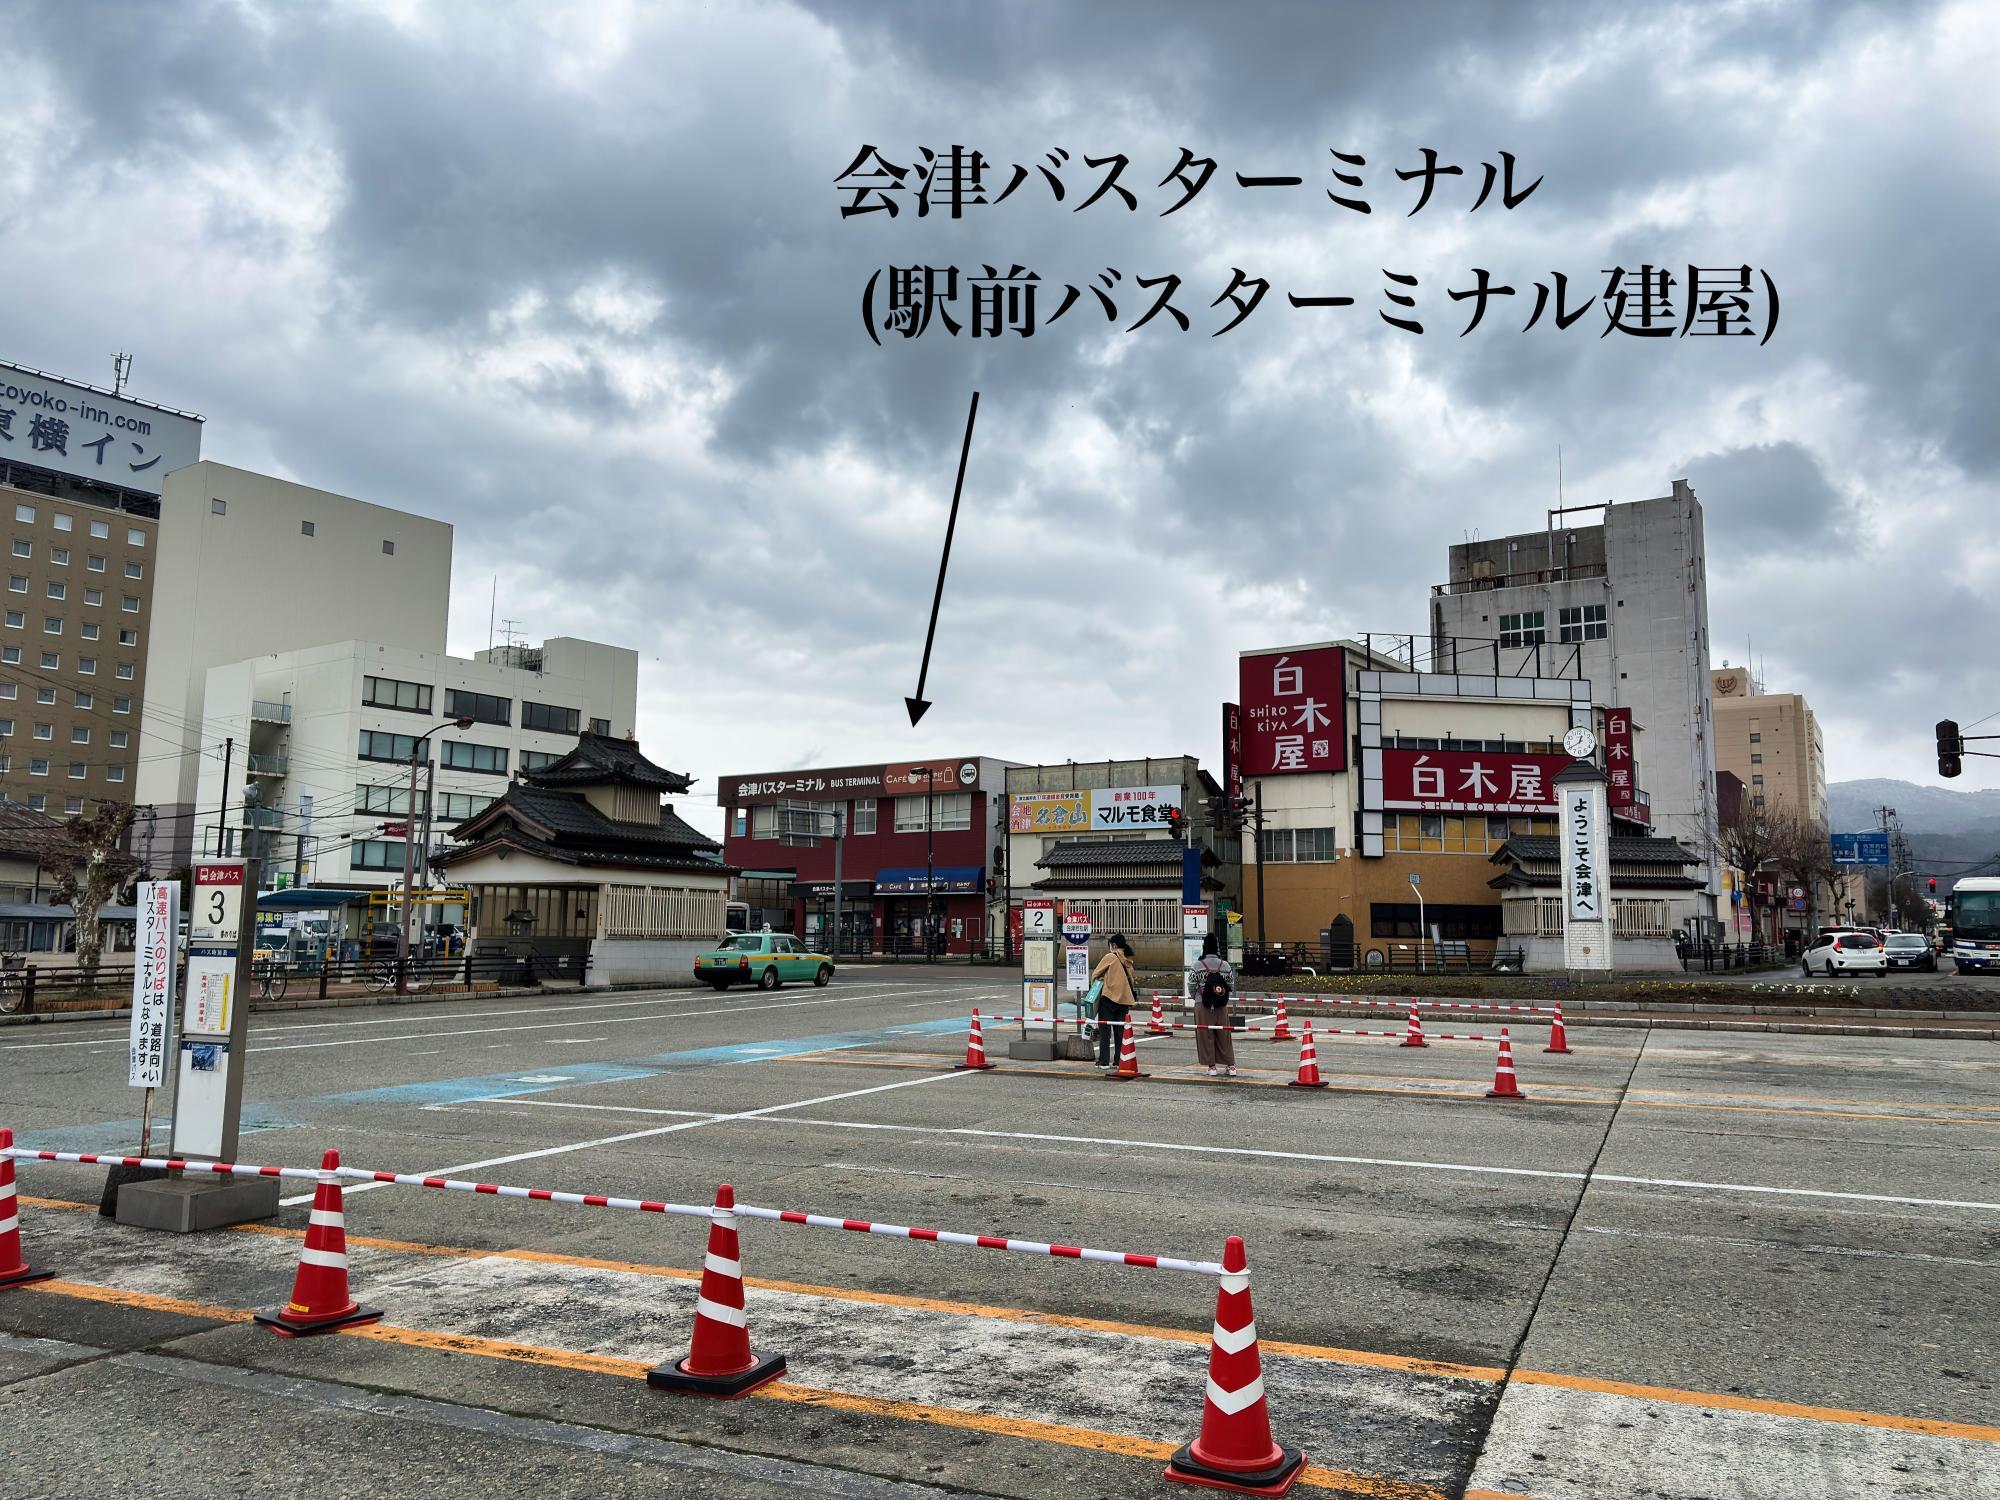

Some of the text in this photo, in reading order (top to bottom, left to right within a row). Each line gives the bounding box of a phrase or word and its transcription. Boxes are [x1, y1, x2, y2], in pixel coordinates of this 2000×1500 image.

[1272, 657, 1332, 770] 白木屋
[1609, 715, 1630, 787] 白木屋
[738, 776, 881, 797] 会津バスターミナル BUS TERMINAL
[1412, 755, 1546, 801] 白木屋
[1114, 791, 1156, 801] 創業100年
[1034, 800, 1087, 825] 名倉山
[1098, 803, 1173, 824] マルモ食堂
[1573, 798, 1594, 911] ようこそ会津へ
[209, 870, 239, 881] 会津バス
[208, 890, 225, 924] 3
[1034, 911, 1044, 926] 2
[1192, 917, 1198, 929] 1
